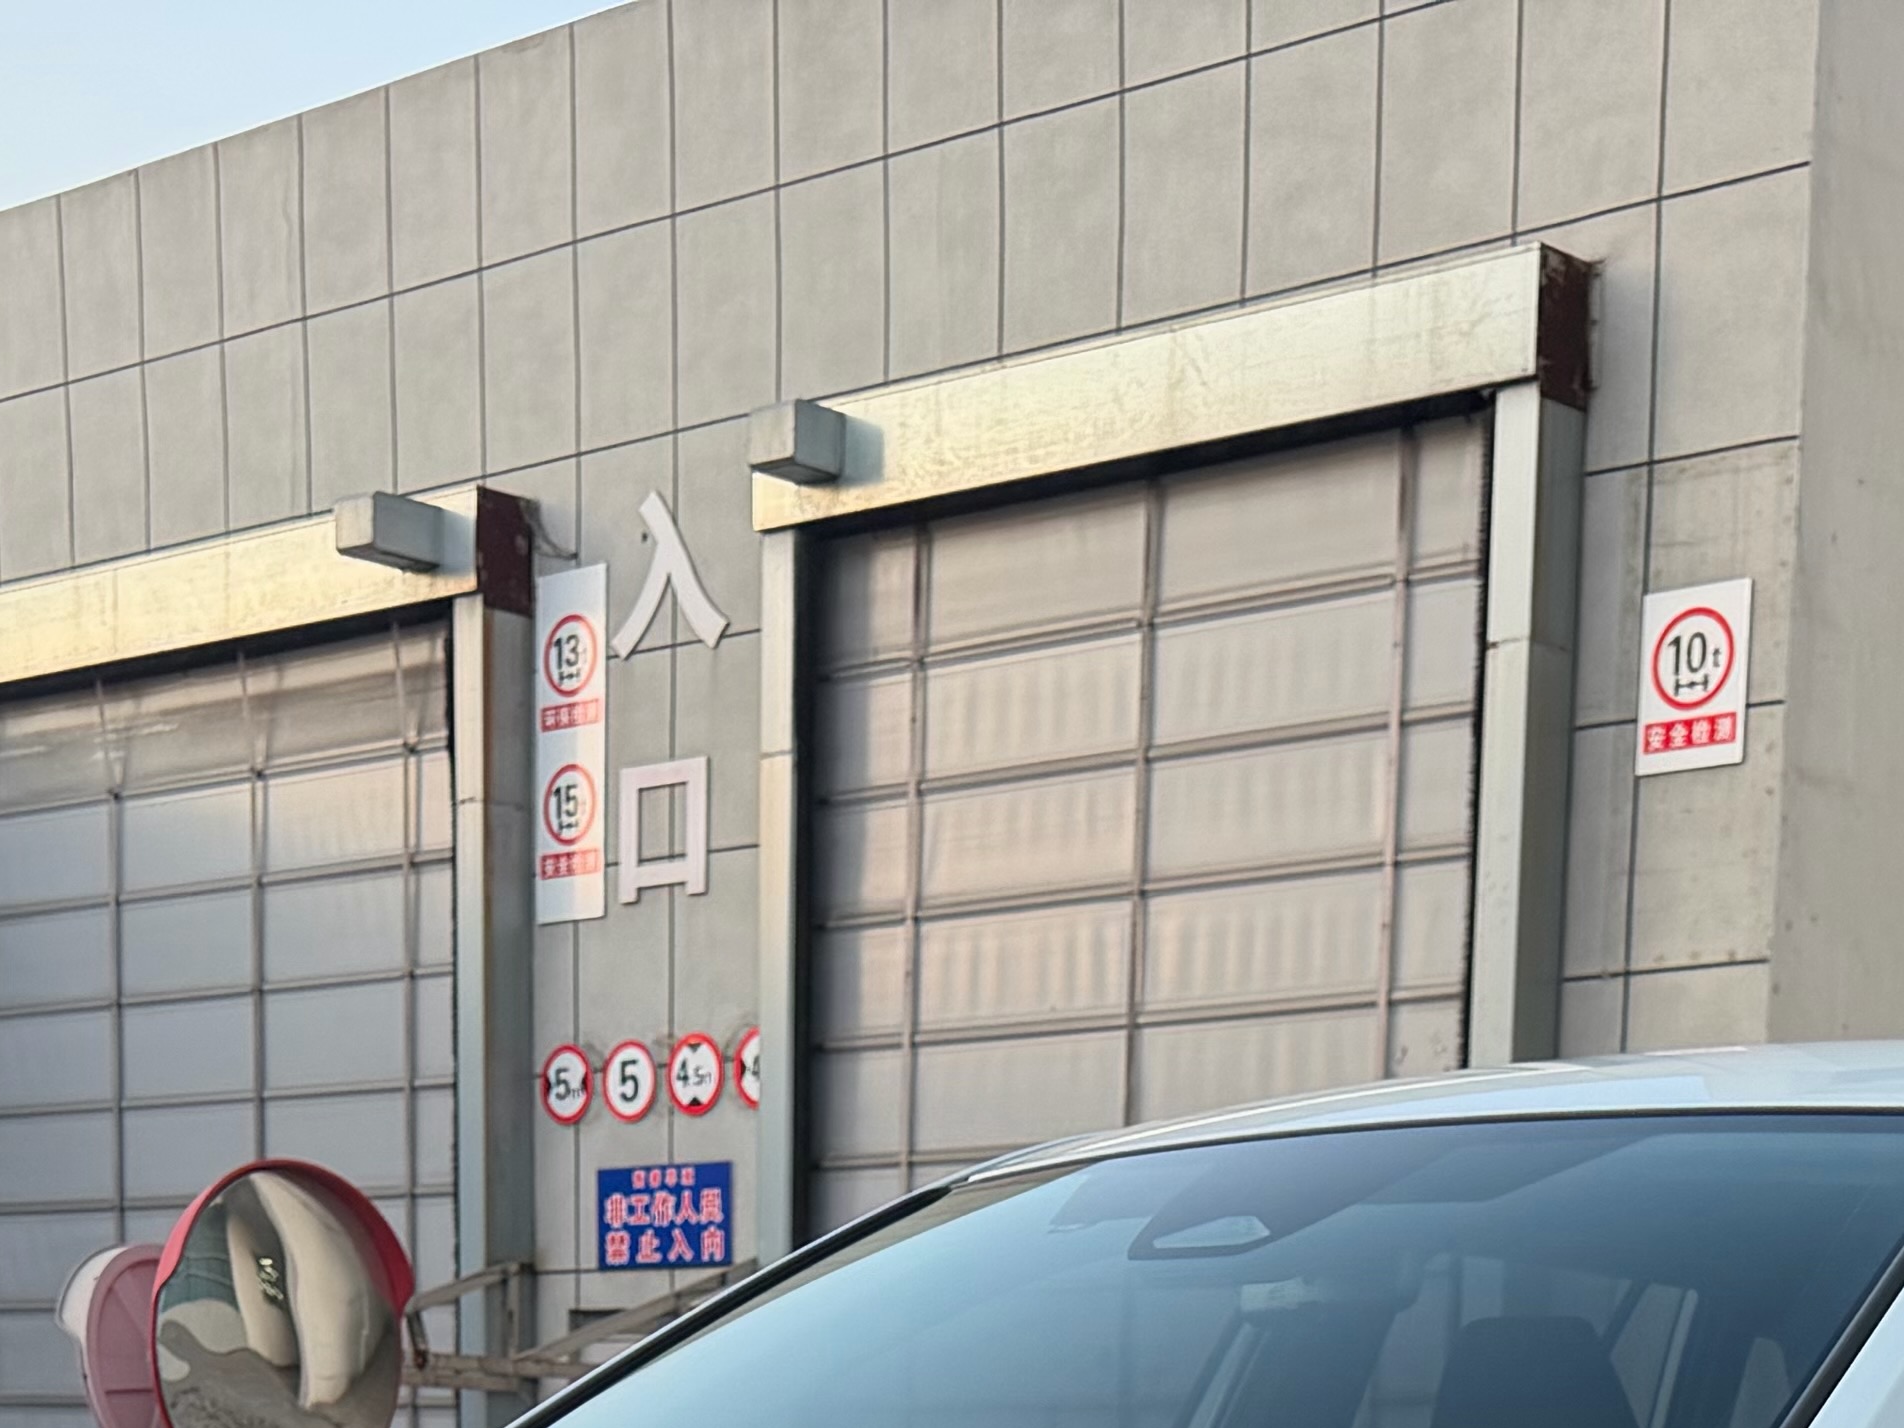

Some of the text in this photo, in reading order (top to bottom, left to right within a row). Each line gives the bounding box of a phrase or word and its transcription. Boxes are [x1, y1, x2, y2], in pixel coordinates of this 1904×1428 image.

[611, 490, 730, 905] 入口
[619, 1059, 638, 1101] 5
[605, 1189, 724, 1228] 非工作人员
[605, 1227, 725, 1265] 禁止入内
